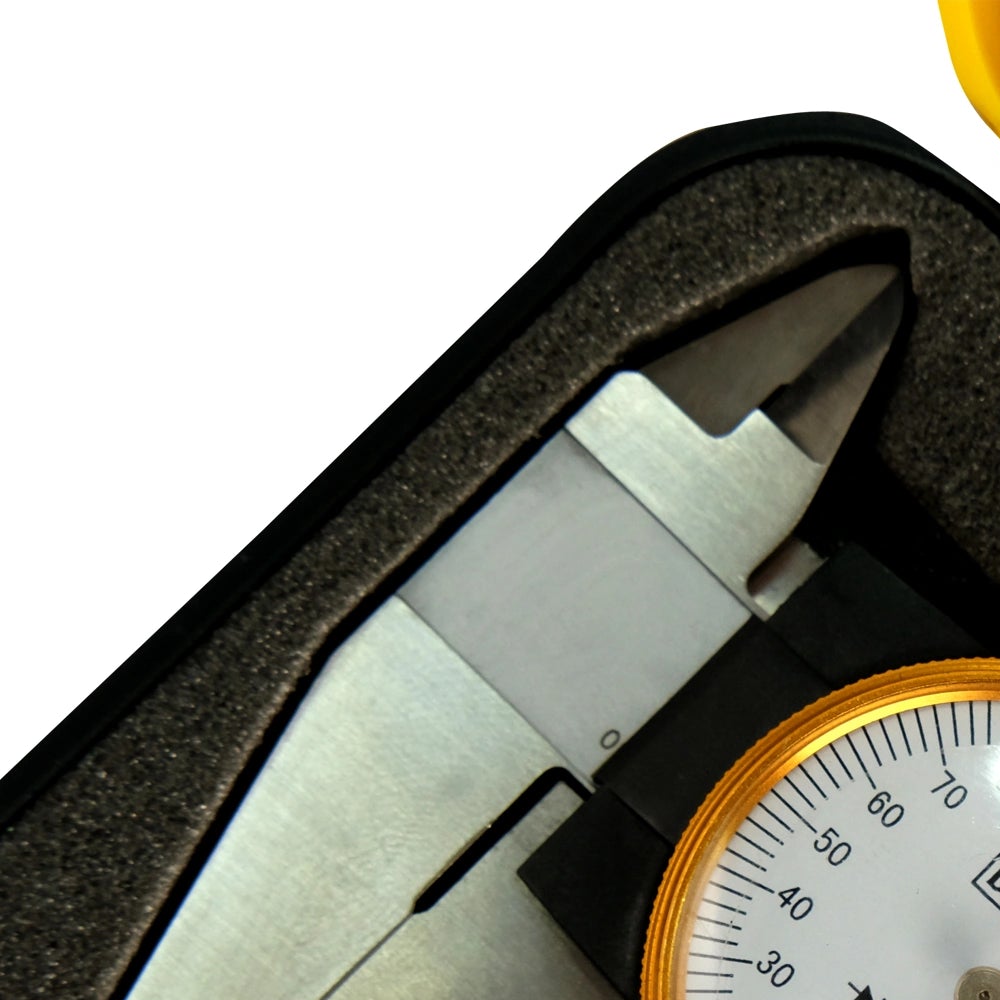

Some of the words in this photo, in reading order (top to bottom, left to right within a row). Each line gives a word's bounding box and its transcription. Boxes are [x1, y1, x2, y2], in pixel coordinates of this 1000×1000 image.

[600, 729, 621, 750] 0
[930, 769, 968, 810] 70
[867, 791, 905, 828] 60
[813, 827, 852, 867] 50
[777, 886, 814, 921] 40
[756, 950, 796, 988] 30
